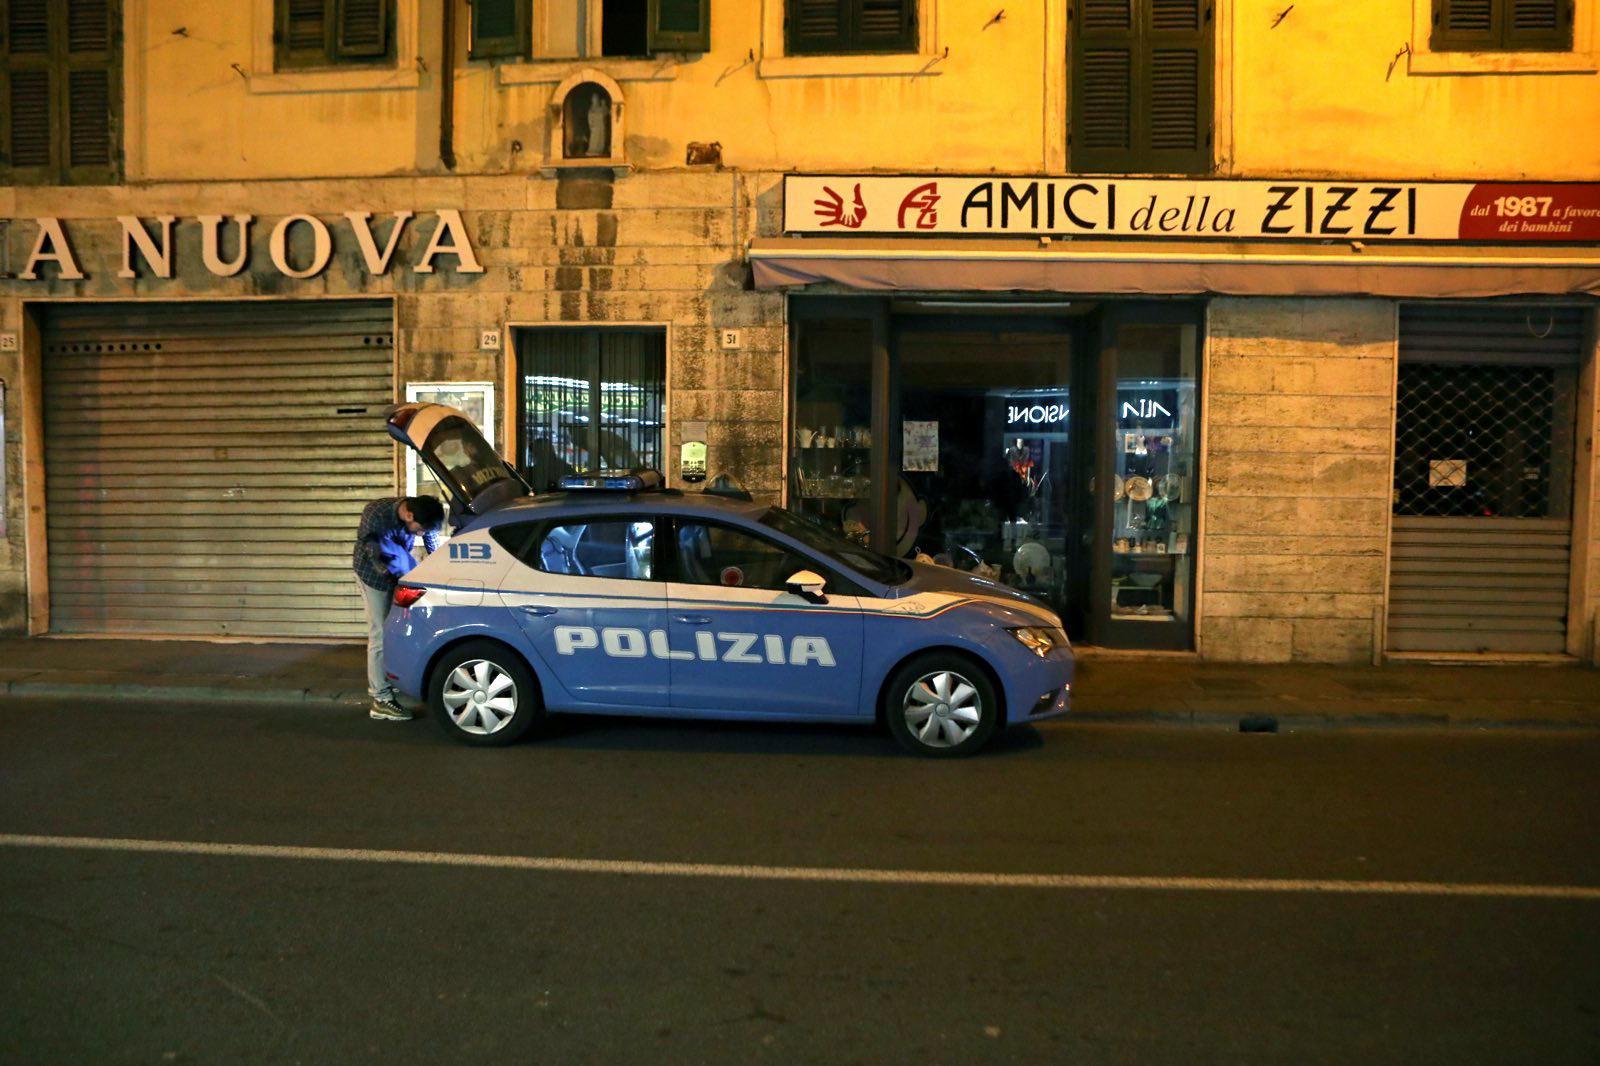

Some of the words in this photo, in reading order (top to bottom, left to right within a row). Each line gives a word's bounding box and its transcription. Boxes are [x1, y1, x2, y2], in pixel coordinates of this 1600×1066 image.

[961, 182, 1116, 230] AMICI
[1129, 195, 1236, 233] della
[1260, 186, 1417, 236] ZIZZI
[1470, 205, 1491, 217] dal
[1494, 196, 1553, 218] 1987
[1498, 221, 1519, 233] dei
[1520, 221, 1574, 233] bambini
[116, 209, 486, 279] NUOVA
[483, 334, 498, 346] 29
[726, 333, 737, 345] 31
[448, 543, 493, 560] 113
[553, 624, 837, 667] POLIZIA
